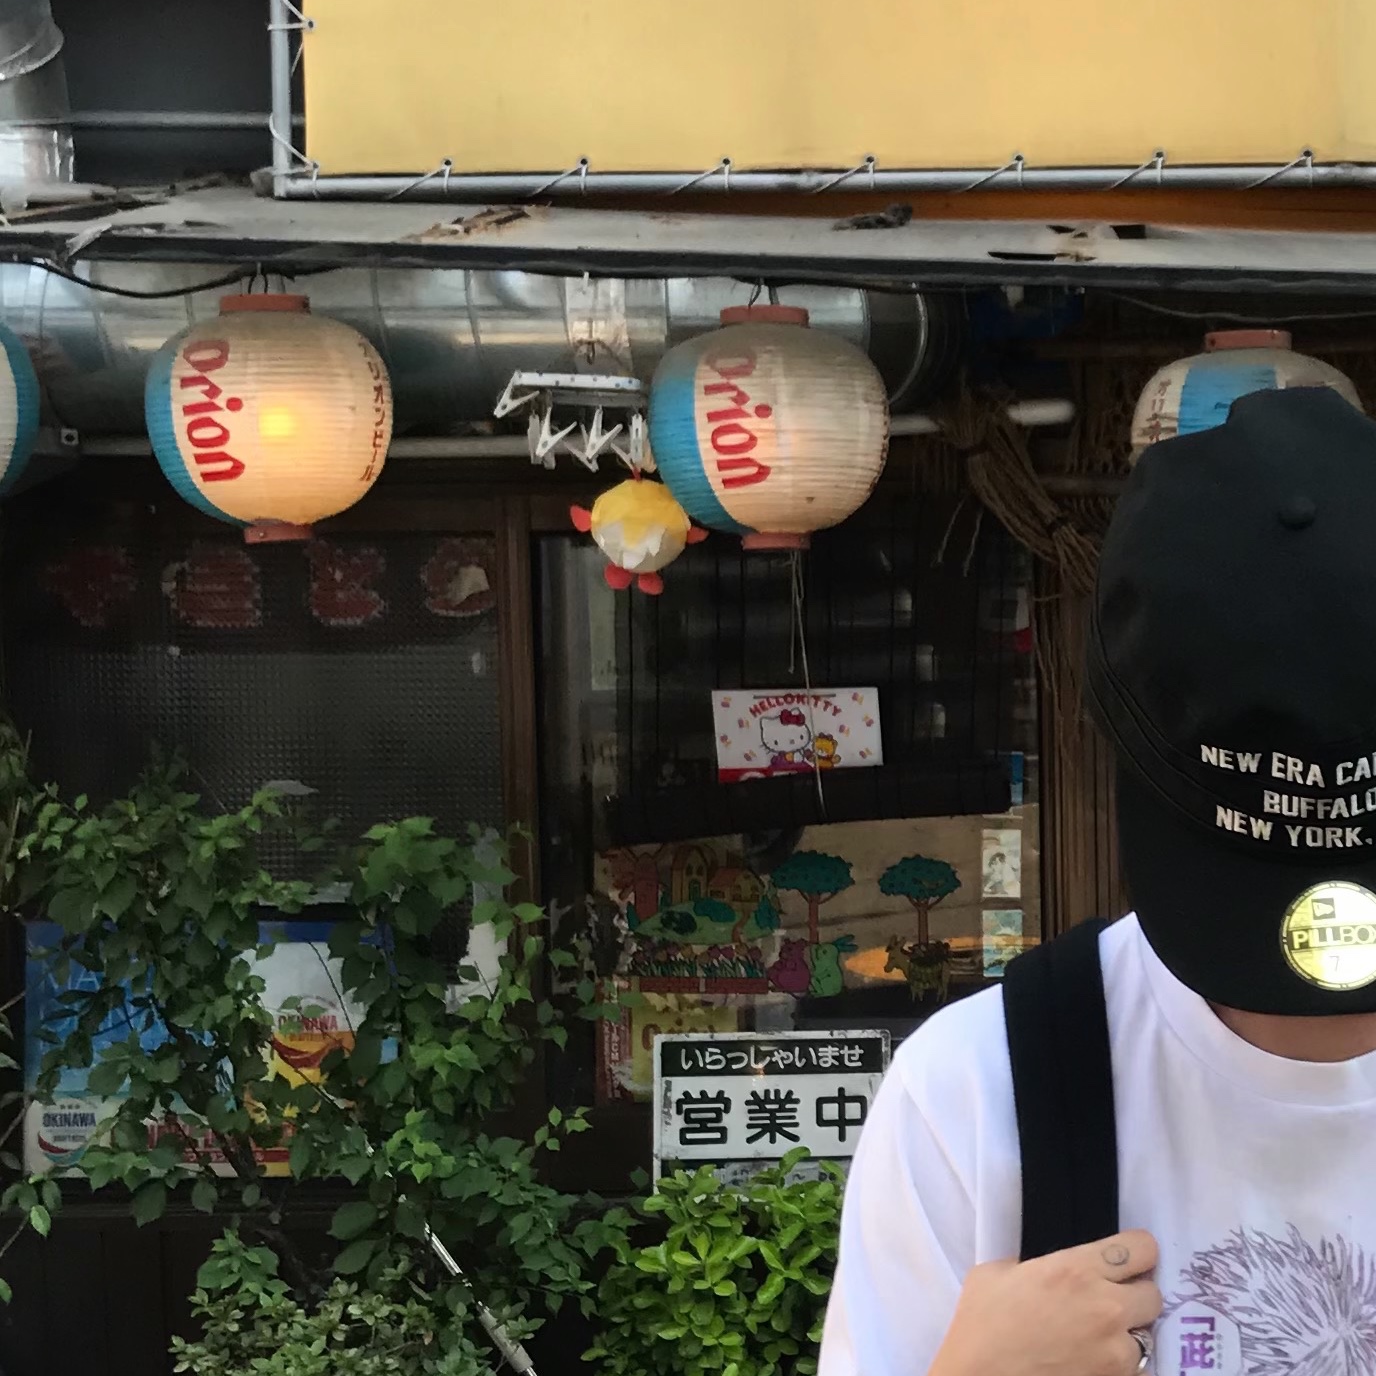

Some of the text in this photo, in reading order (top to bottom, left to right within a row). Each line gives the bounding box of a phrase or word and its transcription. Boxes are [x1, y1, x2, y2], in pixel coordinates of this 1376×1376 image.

[180, 338, 246, 483] Orion
[749, 693, 795, 718] HELLO
[1200, 744, 1262, 774] NEW
[1271, 752, 1325, 788] ERA
[1216, 805, 1273, 841] NEW
[681, 1045, 864, 1070] いらっしゃいませ
[43, 1112, 96, 1127] OKINAWA
[676, 1086, 867, 1145] 営業中
